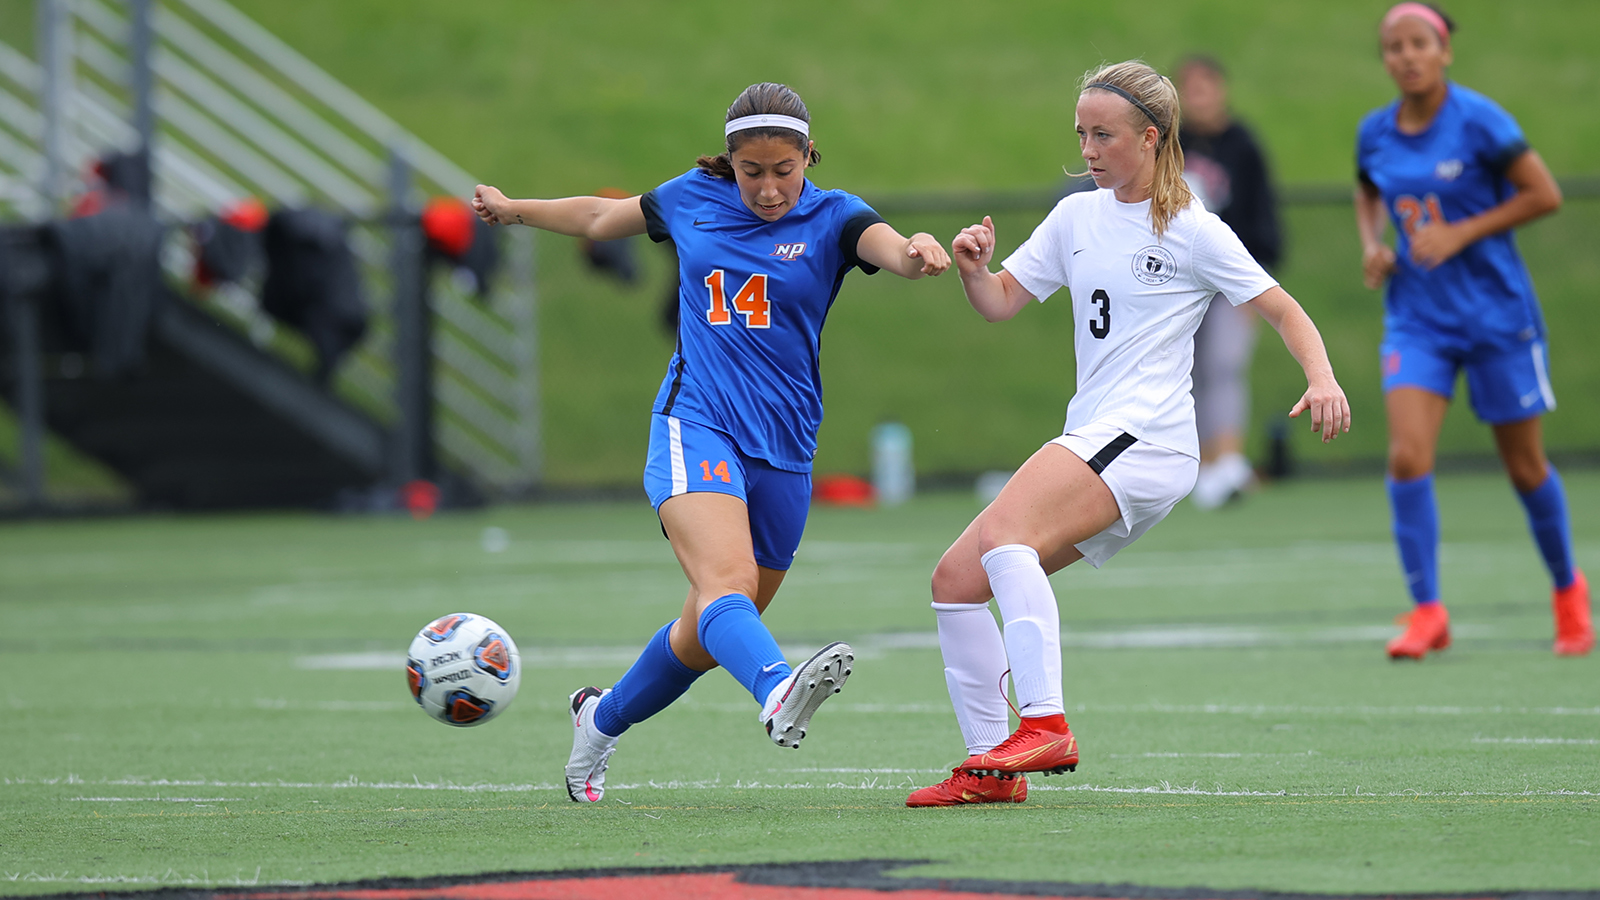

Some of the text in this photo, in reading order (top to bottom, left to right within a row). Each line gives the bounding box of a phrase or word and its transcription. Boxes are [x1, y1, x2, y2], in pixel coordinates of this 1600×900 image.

[771, 242, 807, 260] NP
[704, 269, 771, 329] 14
[1089, 288, 1111, 340] 3
[700, 460, 731, 482] 14
